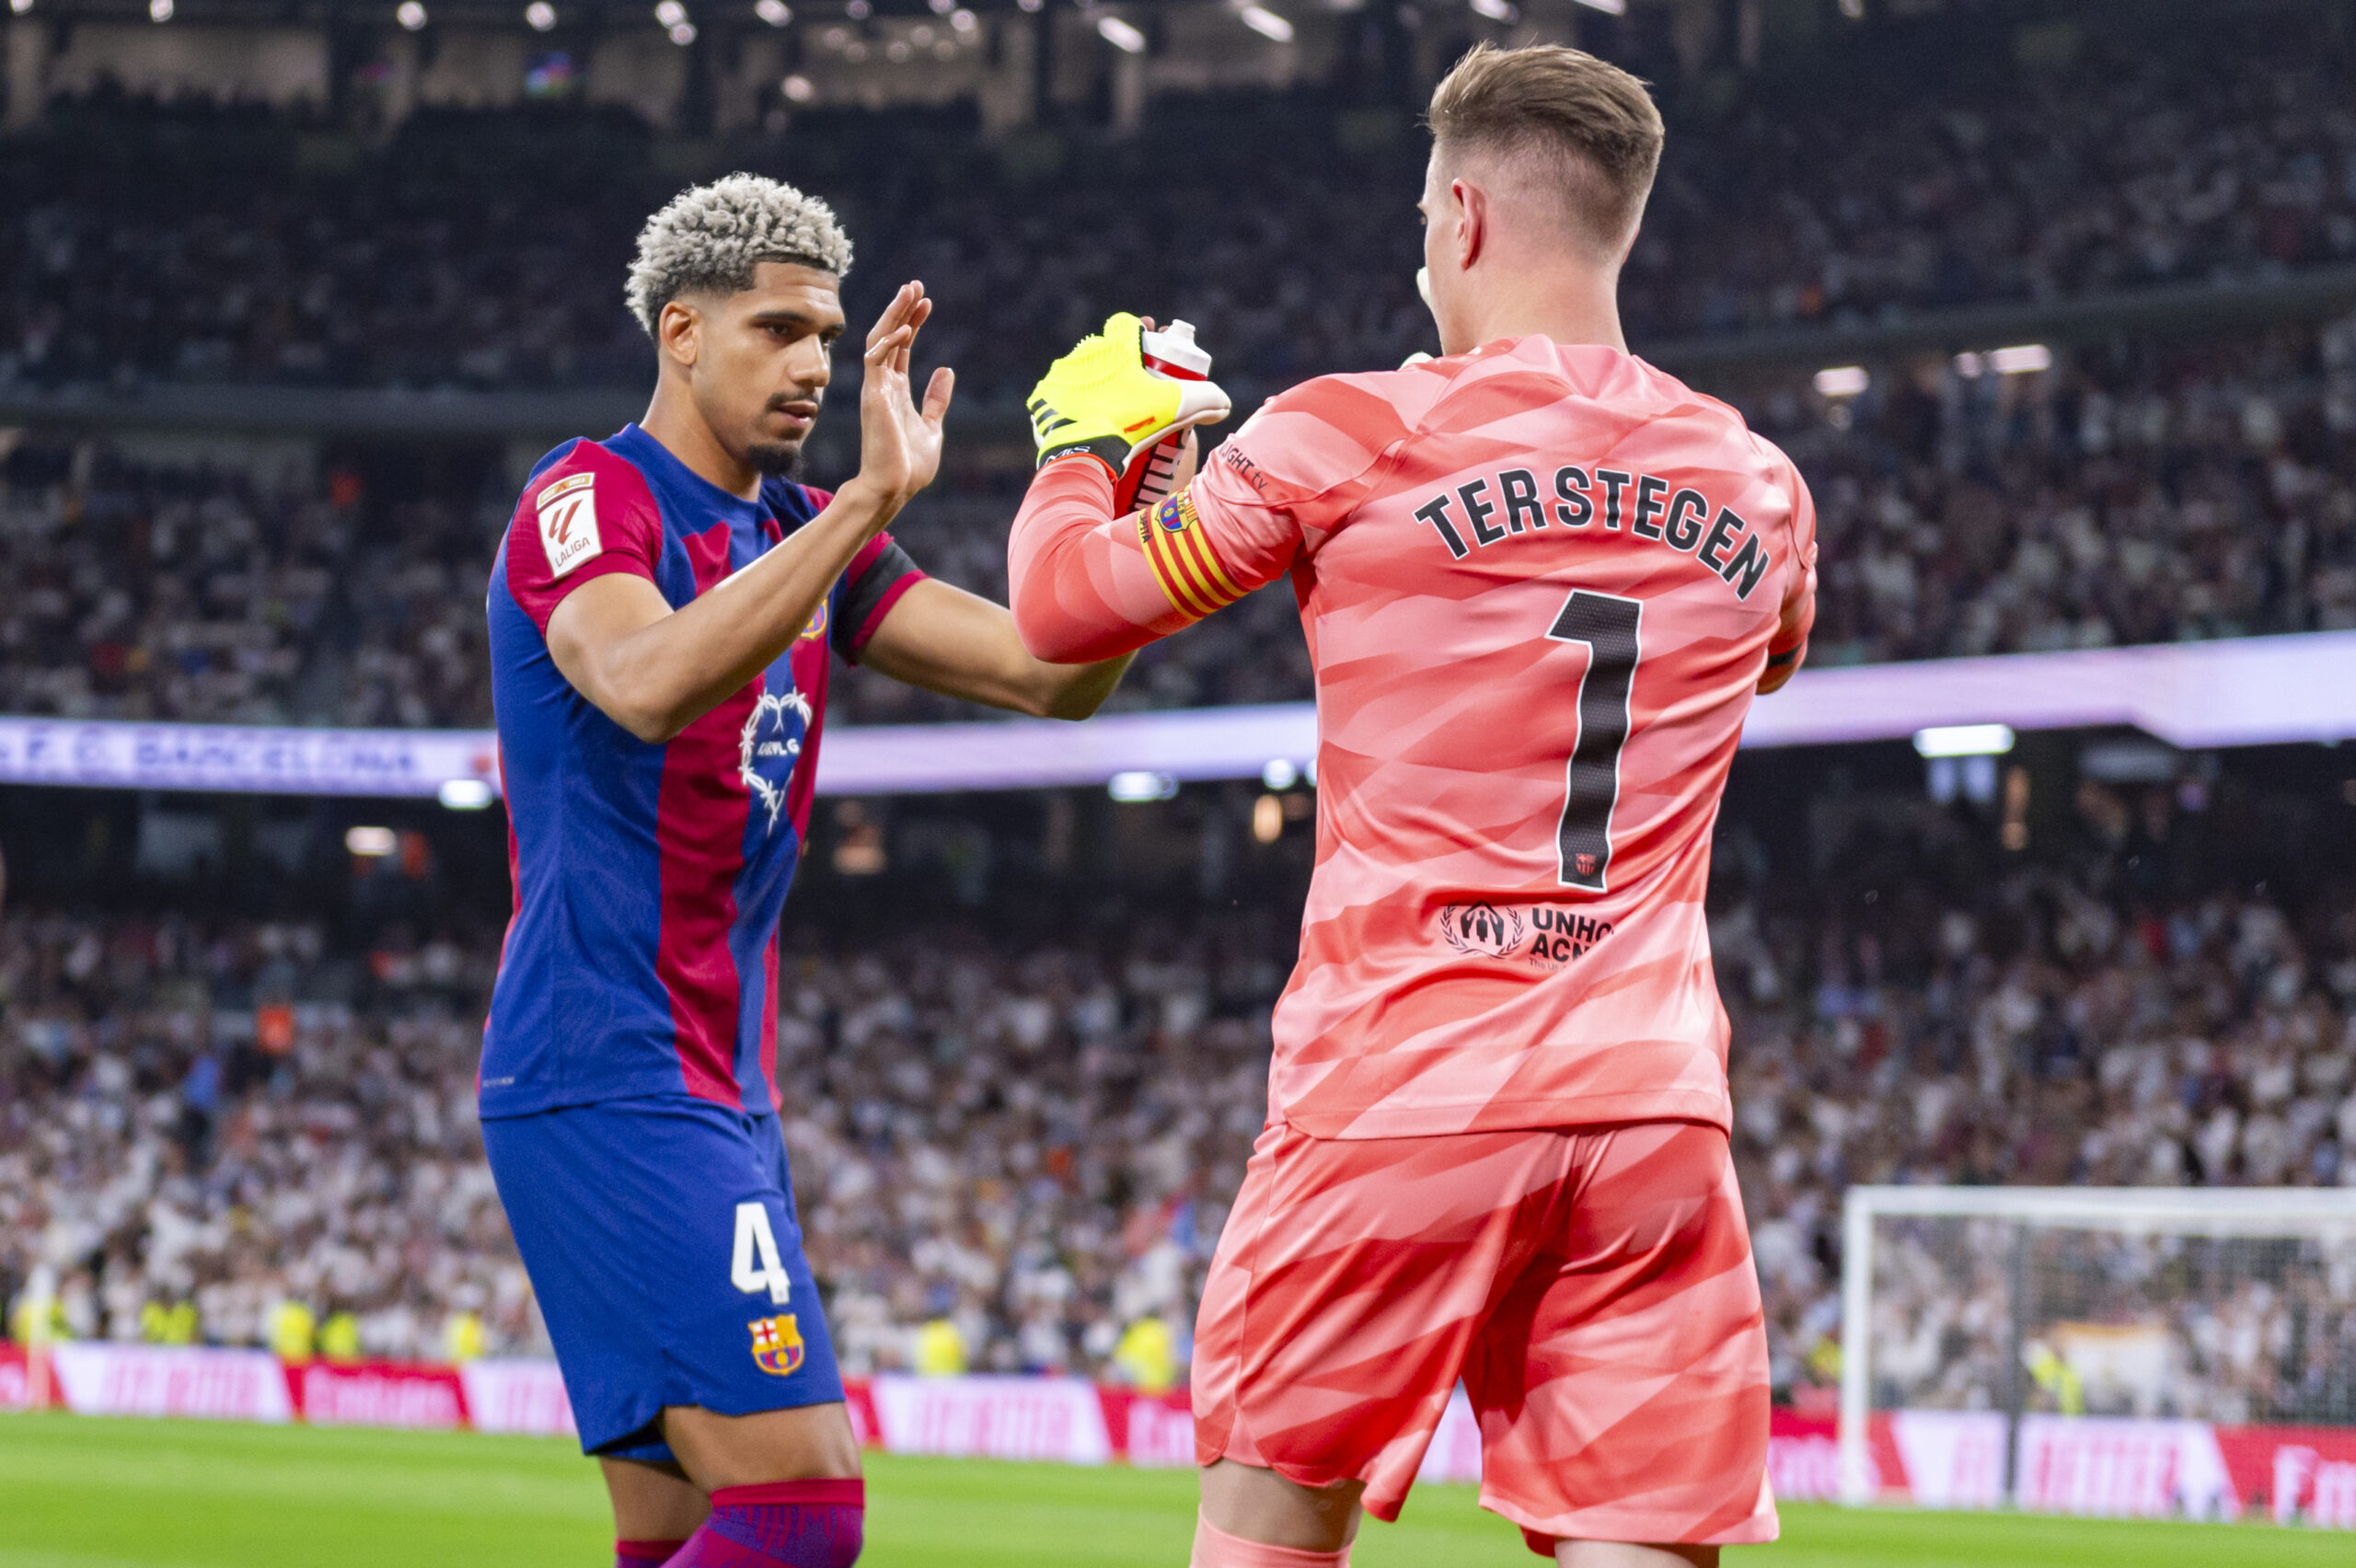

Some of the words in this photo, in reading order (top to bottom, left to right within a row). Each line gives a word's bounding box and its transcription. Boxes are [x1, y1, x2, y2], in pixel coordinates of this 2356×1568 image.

[1252, 471, 1268, 490] tv
[555, 536, 591, 568] LALIGA
[786, 738, 801, 755] G
[1544, 588, 1644, 893] 1
[1532, 907, 1614, 943] UNHC
[1530, 932, 1591, 963] ACN
[731, 1202, 791, 1305] 4
